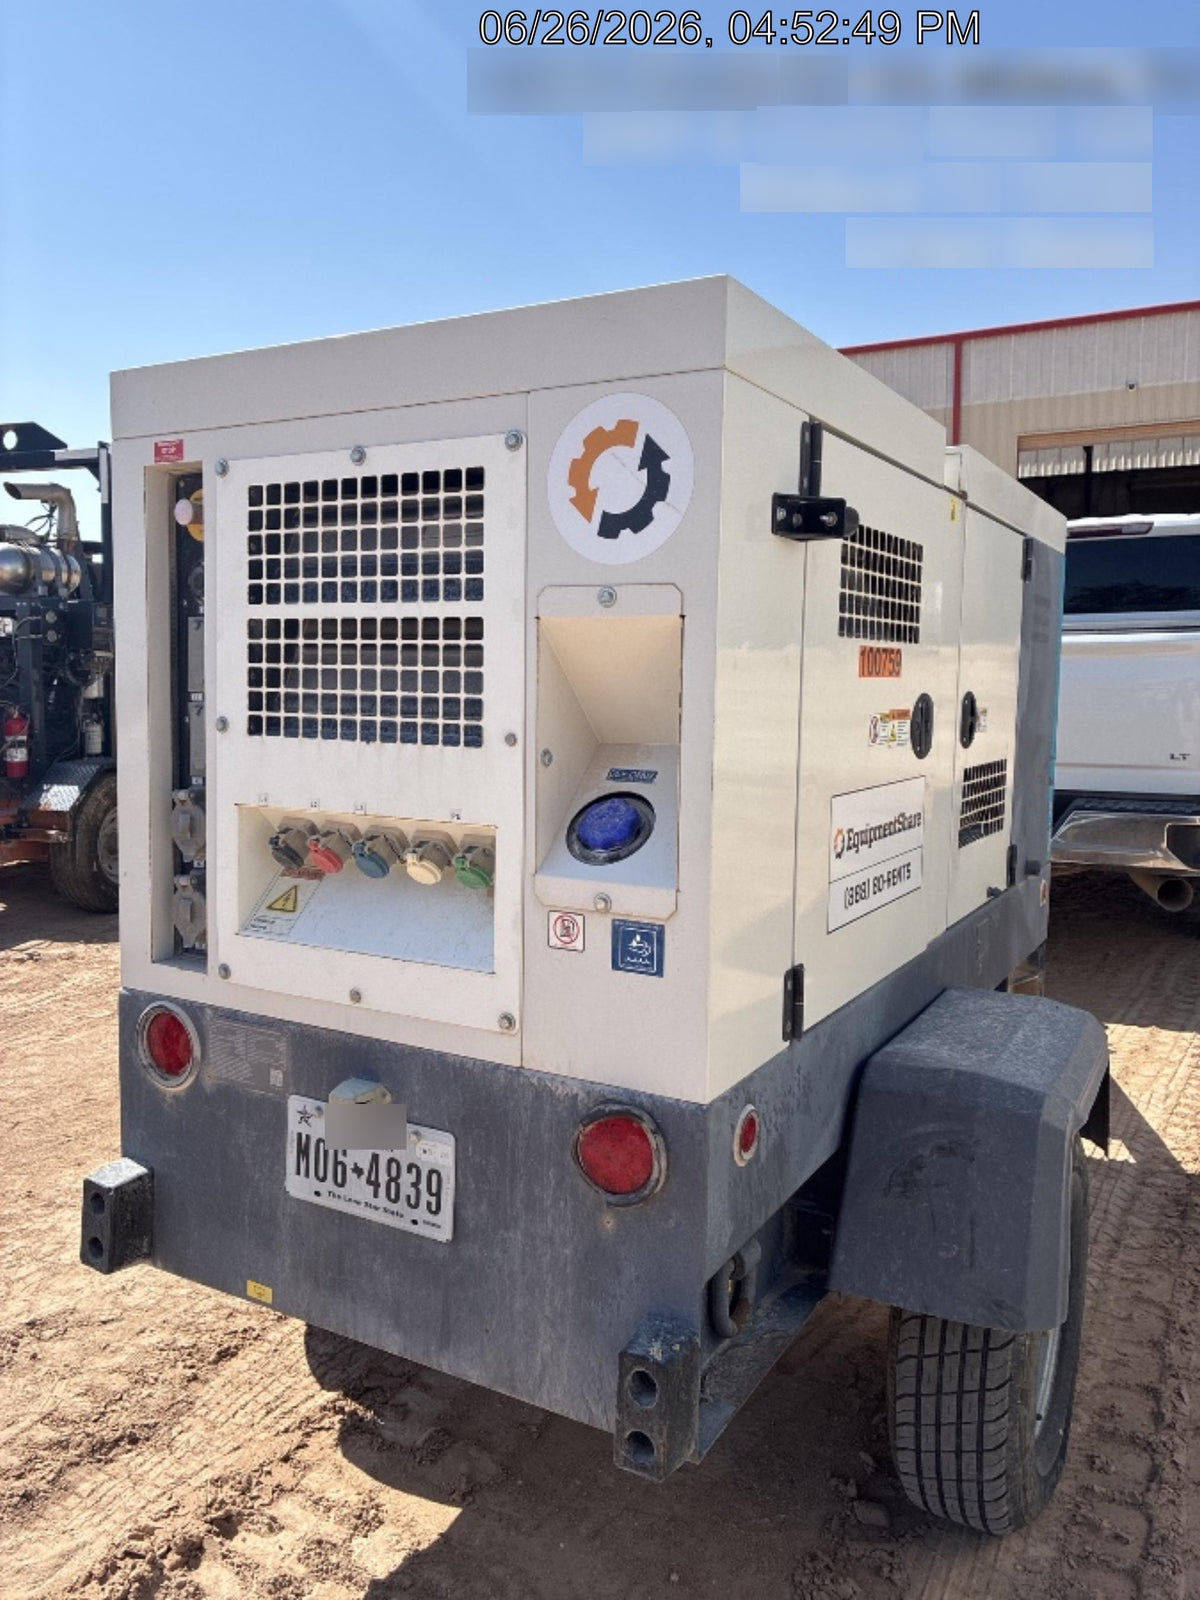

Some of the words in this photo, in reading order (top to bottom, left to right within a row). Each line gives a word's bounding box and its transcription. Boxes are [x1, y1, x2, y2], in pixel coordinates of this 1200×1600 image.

[860, 646, 902, 677] 100759
[1169, 753, 1191, 761] LT
[846, 812, 922, 854] EquipmentShare
[366, 1152, 443, 1216] 4839
